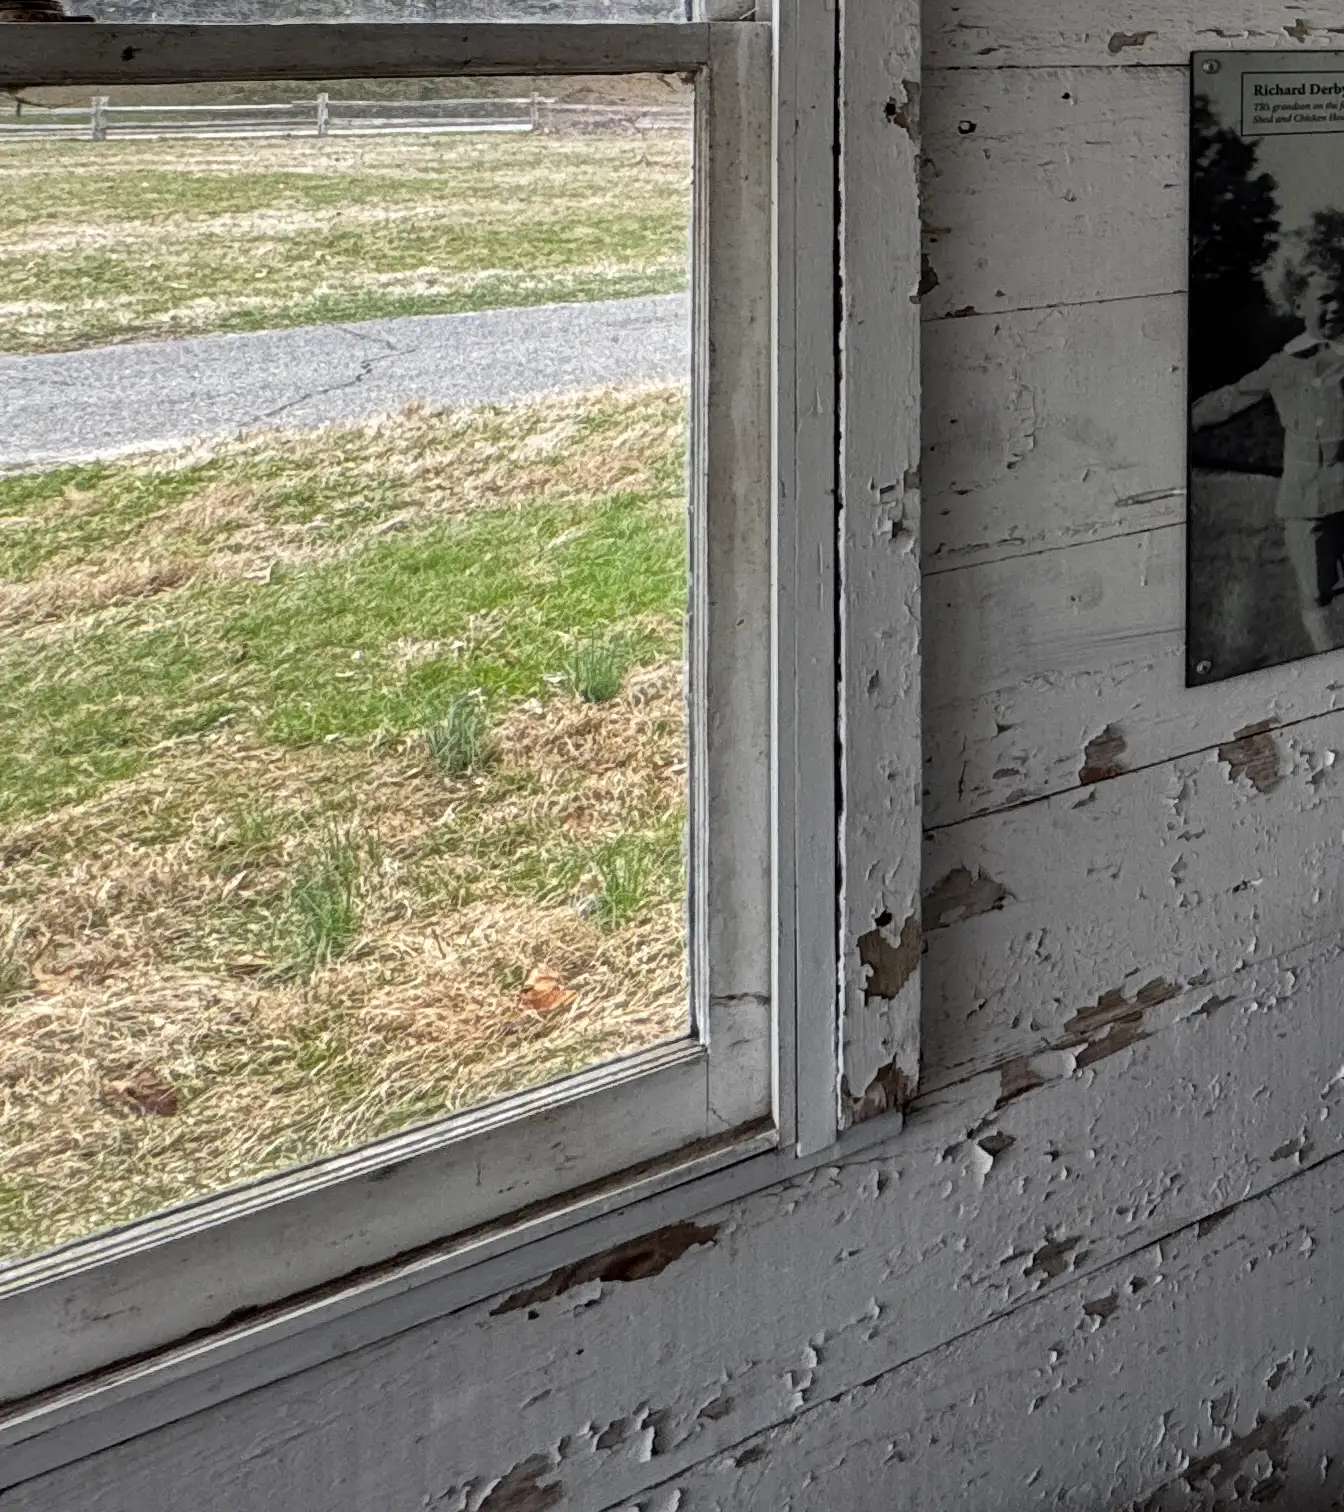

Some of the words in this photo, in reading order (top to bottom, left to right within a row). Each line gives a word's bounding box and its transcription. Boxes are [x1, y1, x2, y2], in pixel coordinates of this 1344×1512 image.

[1253, 83, 1306, 96] Richard
[1325, 101, 1338, 110] the
[1275, 113, 1292, 123] and
[1293, 113, 1327, 123] Chicken
